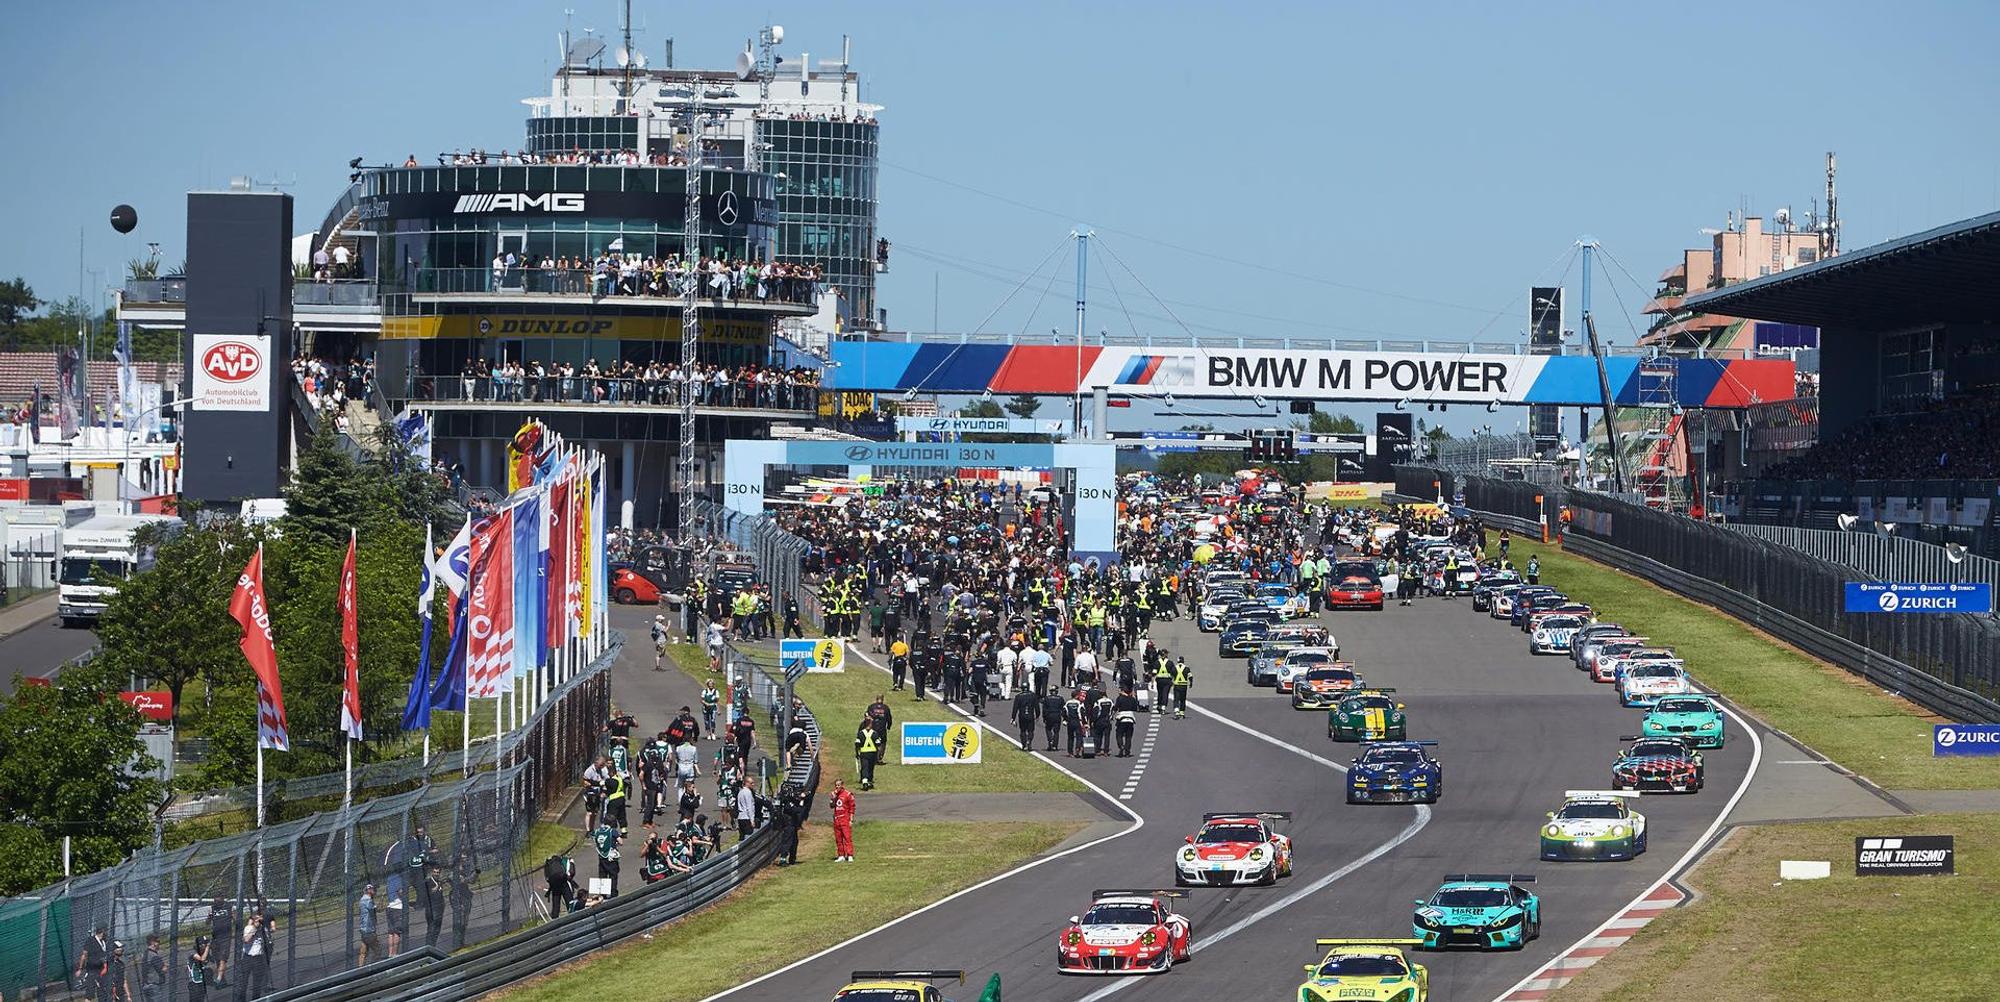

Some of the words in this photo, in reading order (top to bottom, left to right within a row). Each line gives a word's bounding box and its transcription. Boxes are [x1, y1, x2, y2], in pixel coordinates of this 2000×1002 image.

[490, 193, 585, 212] AMG
[500, 319, 613, 334] DUNLOP
[1208, 356, 1307, 388] BMW
[1318, 358, 1351, 390] M
[1365, 359, 1508, 393] POWER
[205, 388, 258, 397] Automobilclub
[217, 398, 261, 406] Deutschland
[845, 392, 872, 407] ADAC
[953, 420, 1008, 431] HYUNDAI
[877, 449, 949, 460] HYUNDAI
[959, 448, 981, 461] i30
[985, 449, 995, 461] N
[728, 483, 747, 494] i30
[750, 484, 760, 494] N
[1079, 488, 1098, 499] i30
[1102, 489, 1112, 499] N
[1901, 597, 1957, 609] ZURICH
[782, 650, 813, 659] BILSTEIN
[905, 736, 942, 746] BILSTEIN
[1957, 732, 2000, 743] ZURIC
[1860, 850, 1893, 863] GRAN
[1895, 849, 1946, 862] TURISMO
